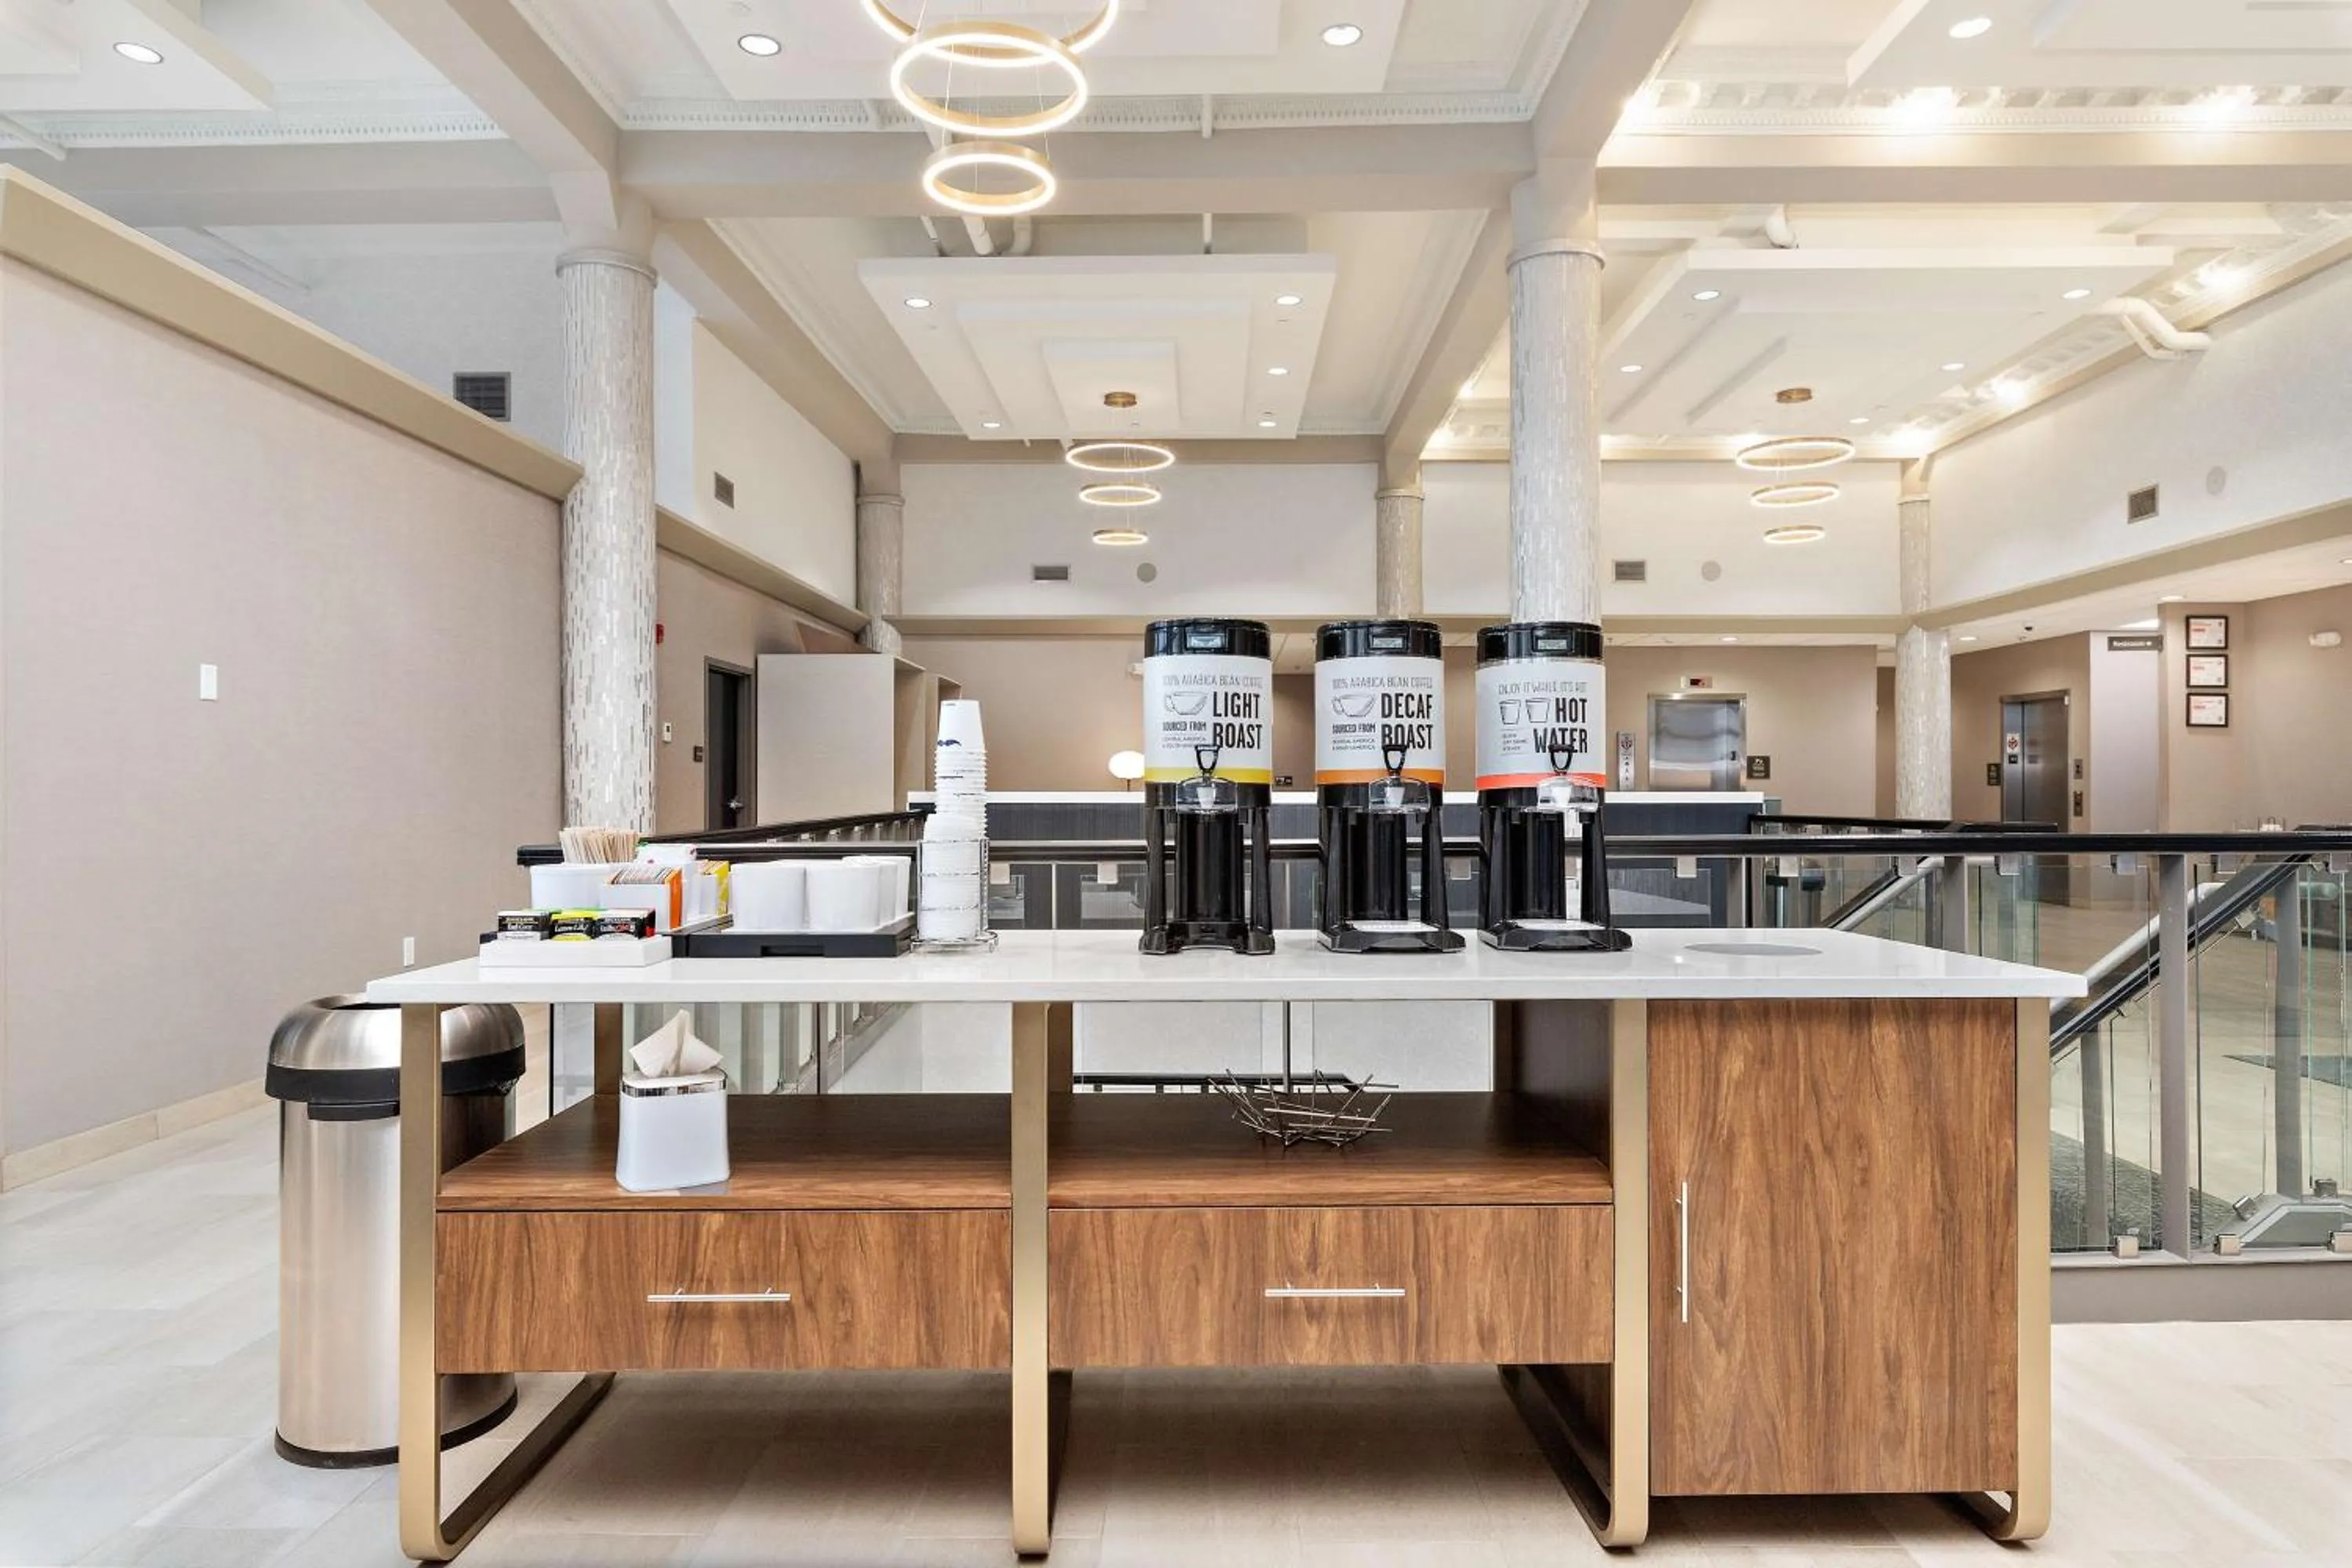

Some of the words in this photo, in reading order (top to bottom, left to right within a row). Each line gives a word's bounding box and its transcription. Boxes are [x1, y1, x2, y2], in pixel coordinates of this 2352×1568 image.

[1498, 682, 1521, 695] ENJOY
[1213, 691, 1261, 719] LIGHT
[1381, 693, 1433, 719] DECAF
[1555, 697, 1588, 724] HOT
[1163, 721, 1188, 731] SOURCED
[1189, 721, 1207, 731] FROM
[1213, 723, 1263, 750] ROAST
[1332, 724, 1357, 734] SOURCED
[1358, 723, 1376, 733] FROM
[1381, 724, 1434, 750] ROAST
[1534, 728, 1588, 753] WATER
